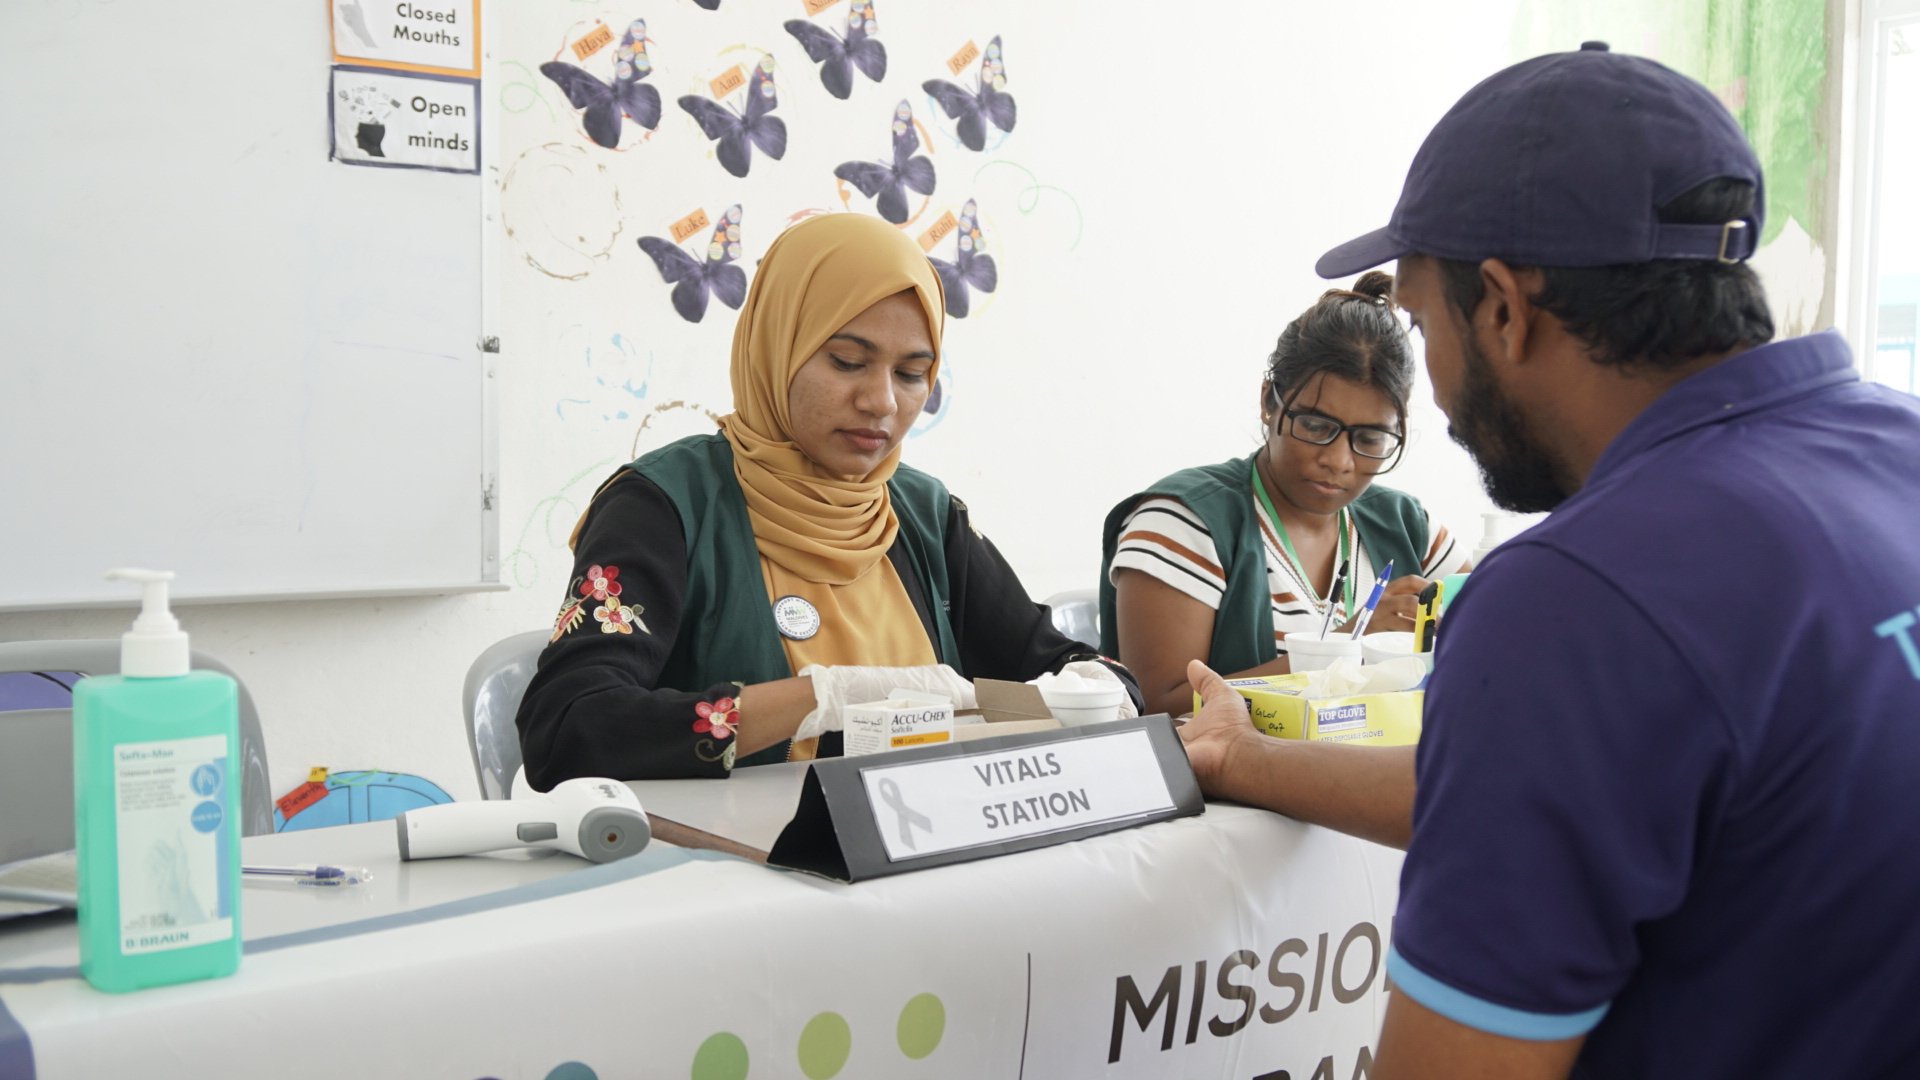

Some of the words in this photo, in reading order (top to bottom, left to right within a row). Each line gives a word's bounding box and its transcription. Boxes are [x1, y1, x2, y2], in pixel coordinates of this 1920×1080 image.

[396, 2, 456, 24] Closed
[393, 24, 460, 46] Mouths
[577, 31, 611, 55] Haya
[411, 96, 466, 119] Open
[408, 131, 469, 151] minds
[675, 216, 705, 239] Luke
[1873, 604, 1920, 681] T
[891, 711, 946, 726] ACCU-CHEK
[1319, 709, 1336, 722] TOP
[1337, 706, 1366, 719] GLOVE
[1363, 730, 1384, 739] GLOVES
[973, 753, 1062, 787] VITALS
[982, 788, 1091, 829] STATION
[125, 937, 135, 948] B
[140, 931, 190, 947] BRAUN
[1108, 914, 1397, 1064] MISSIO
